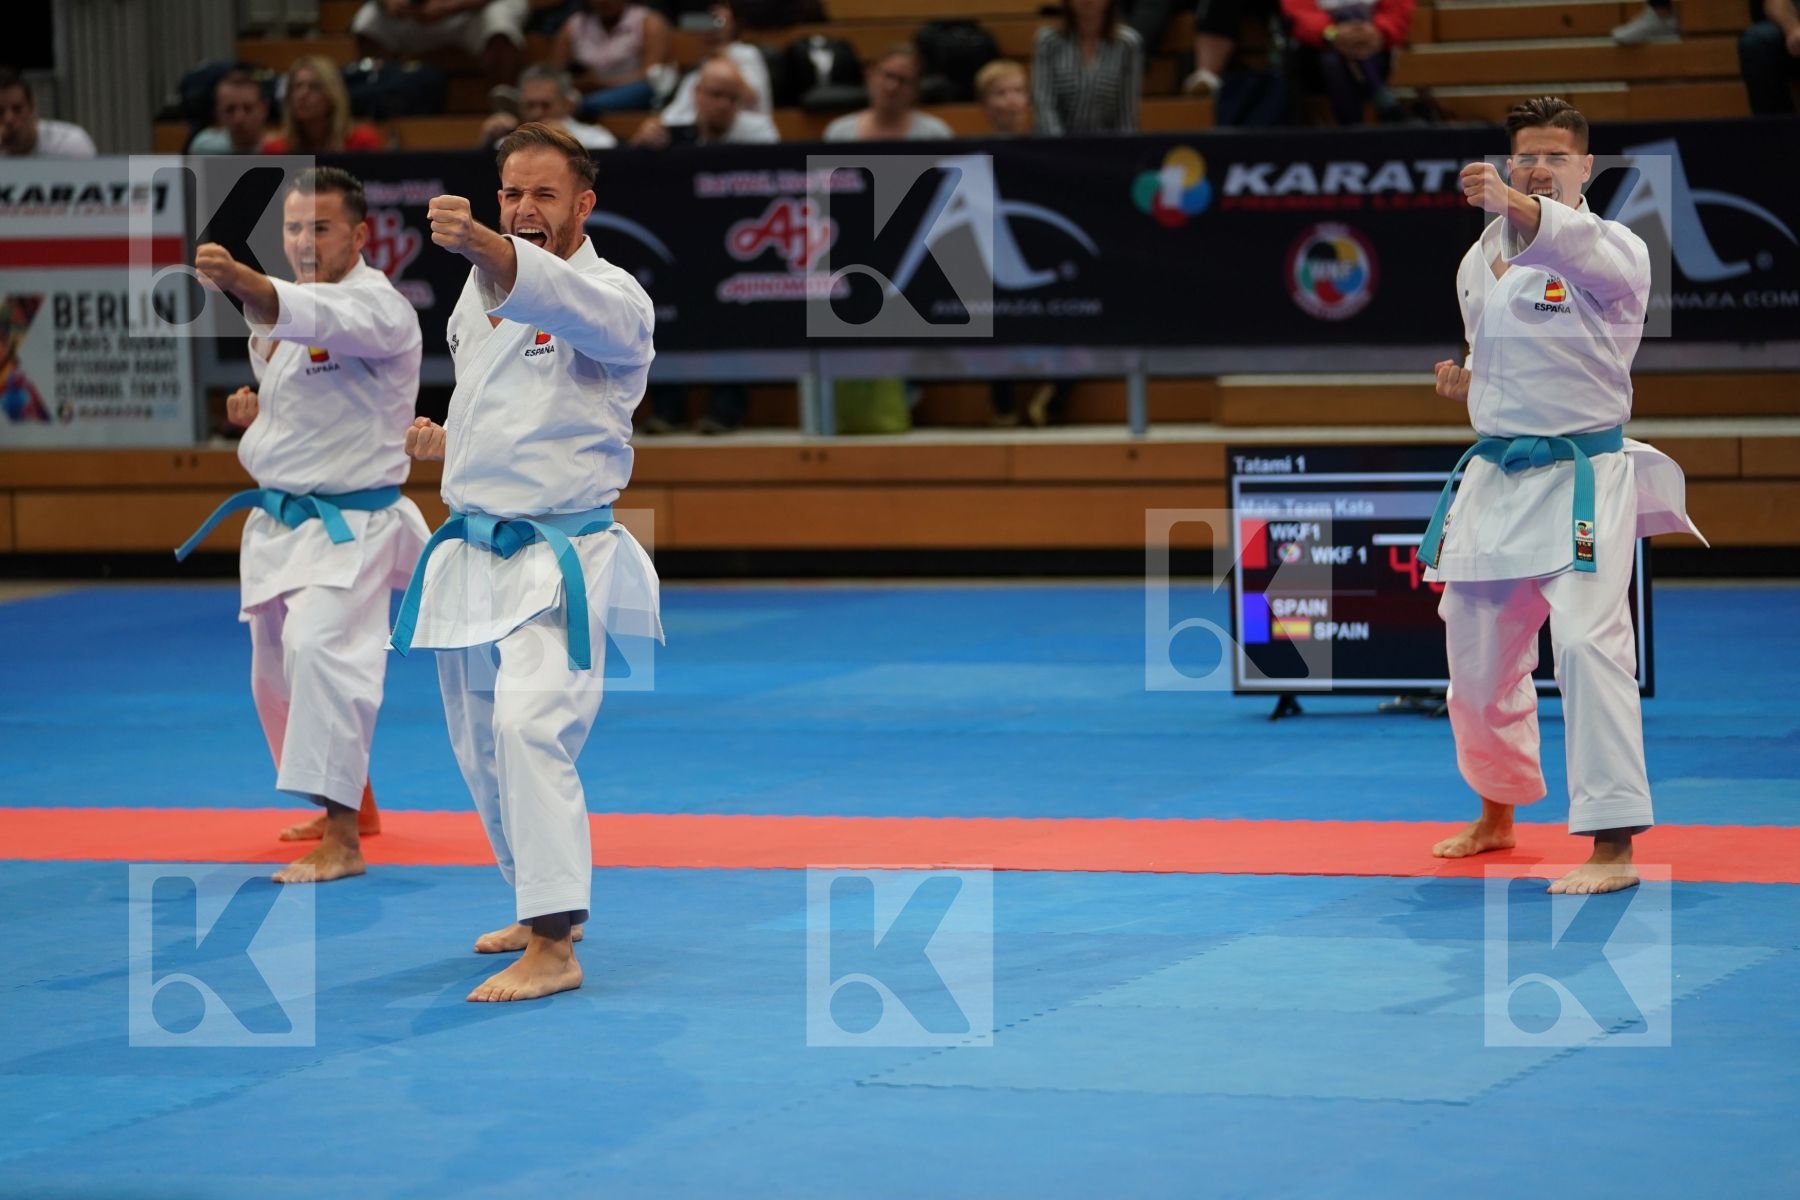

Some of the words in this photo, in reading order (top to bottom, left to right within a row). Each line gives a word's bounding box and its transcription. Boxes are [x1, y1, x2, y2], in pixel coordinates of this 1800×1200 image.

[1223, 160, 1466, 195] KARAT
[53, 291, 177, 330] BERLIN
[1534, 302, 1571, 314] ESPAÑA
[524, 344, 555, 357] ESPAÑA
[1234, 455, 1292, 473] Tatami
[1295, 455, 1306, 472] 1
[1239, 499, 1280, 515] Male
[1284, 499, 1331, 515] Team
[1334, 499, 1375, 516] Kata
[1310, 545, 1353, 564] WKF
[1356, 545, 1367, 564] 1
[1272, 599, 1328, 616] SPAIN
[1313, 622, 1369, 640] SPAIN
